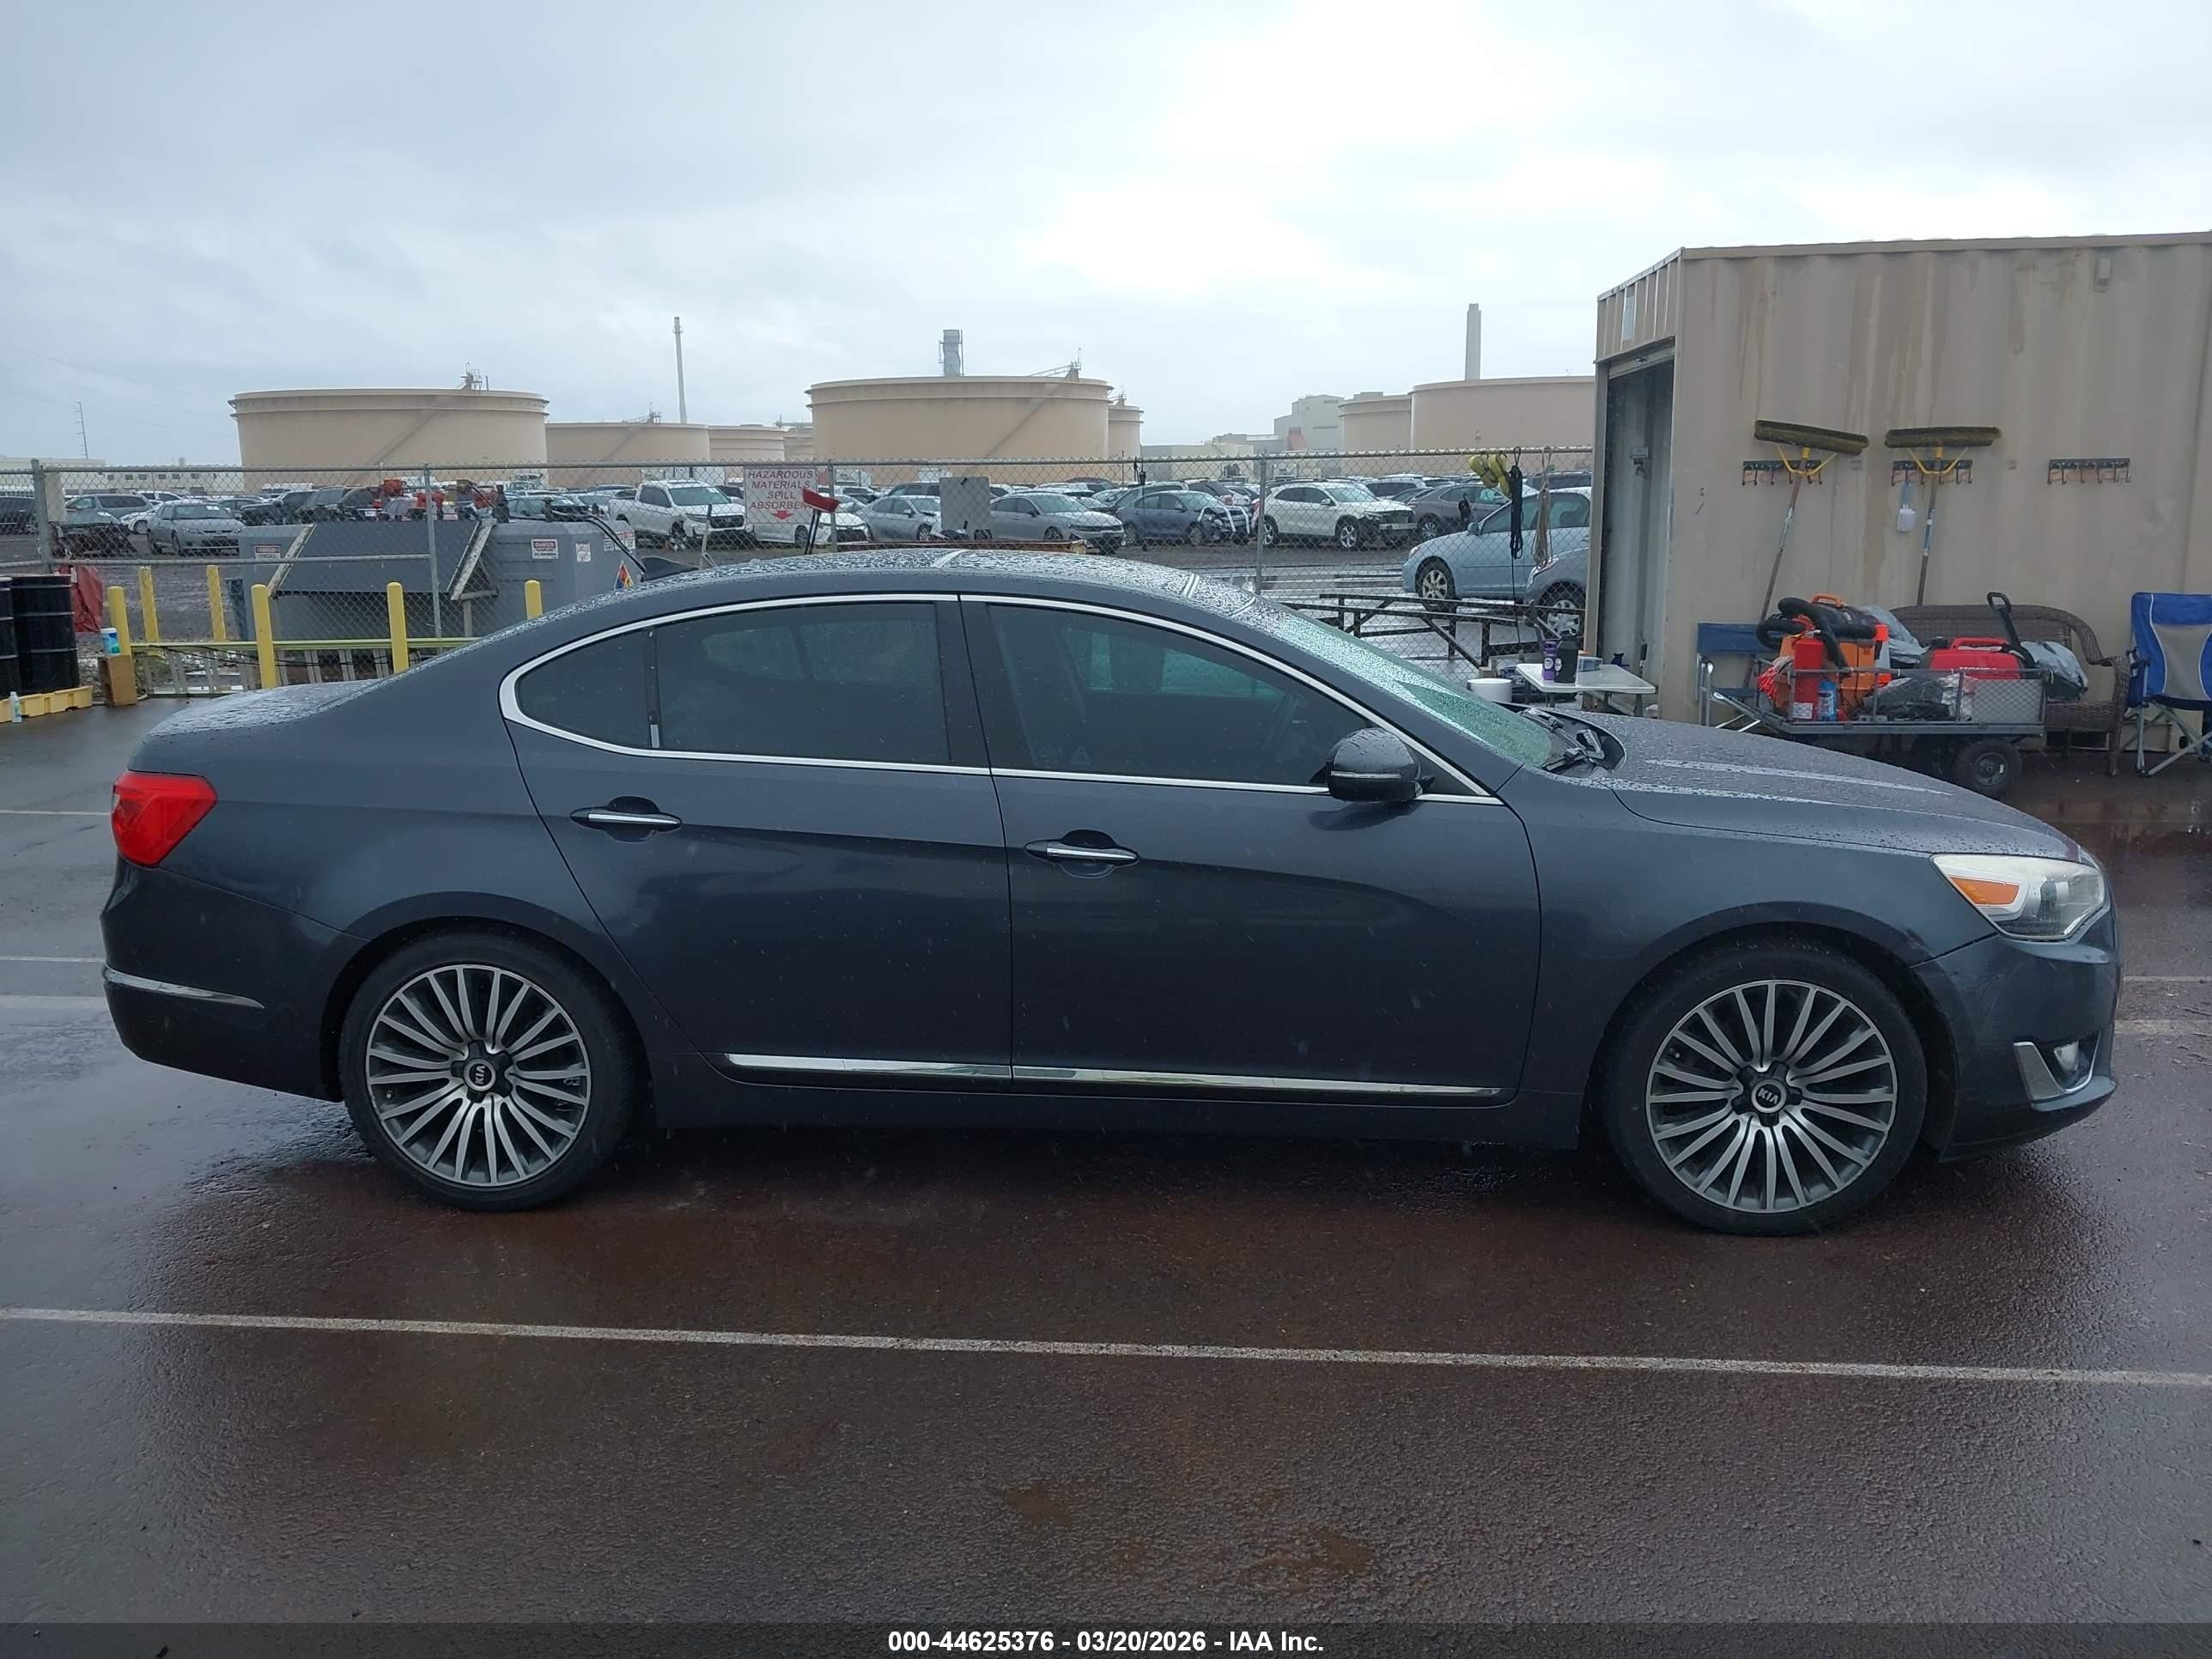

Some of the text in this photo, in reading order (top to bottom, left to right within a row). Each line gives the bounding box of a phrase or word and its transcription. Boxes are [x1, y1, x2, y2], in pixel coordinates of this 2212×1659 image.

[748, 471, 813, 479] HAZARDOUS
[767, 491, 796, 500] SPILL
[475, 1066, 486, 1085] KIA
[1758, 1088, 1778, 1104] KIA
